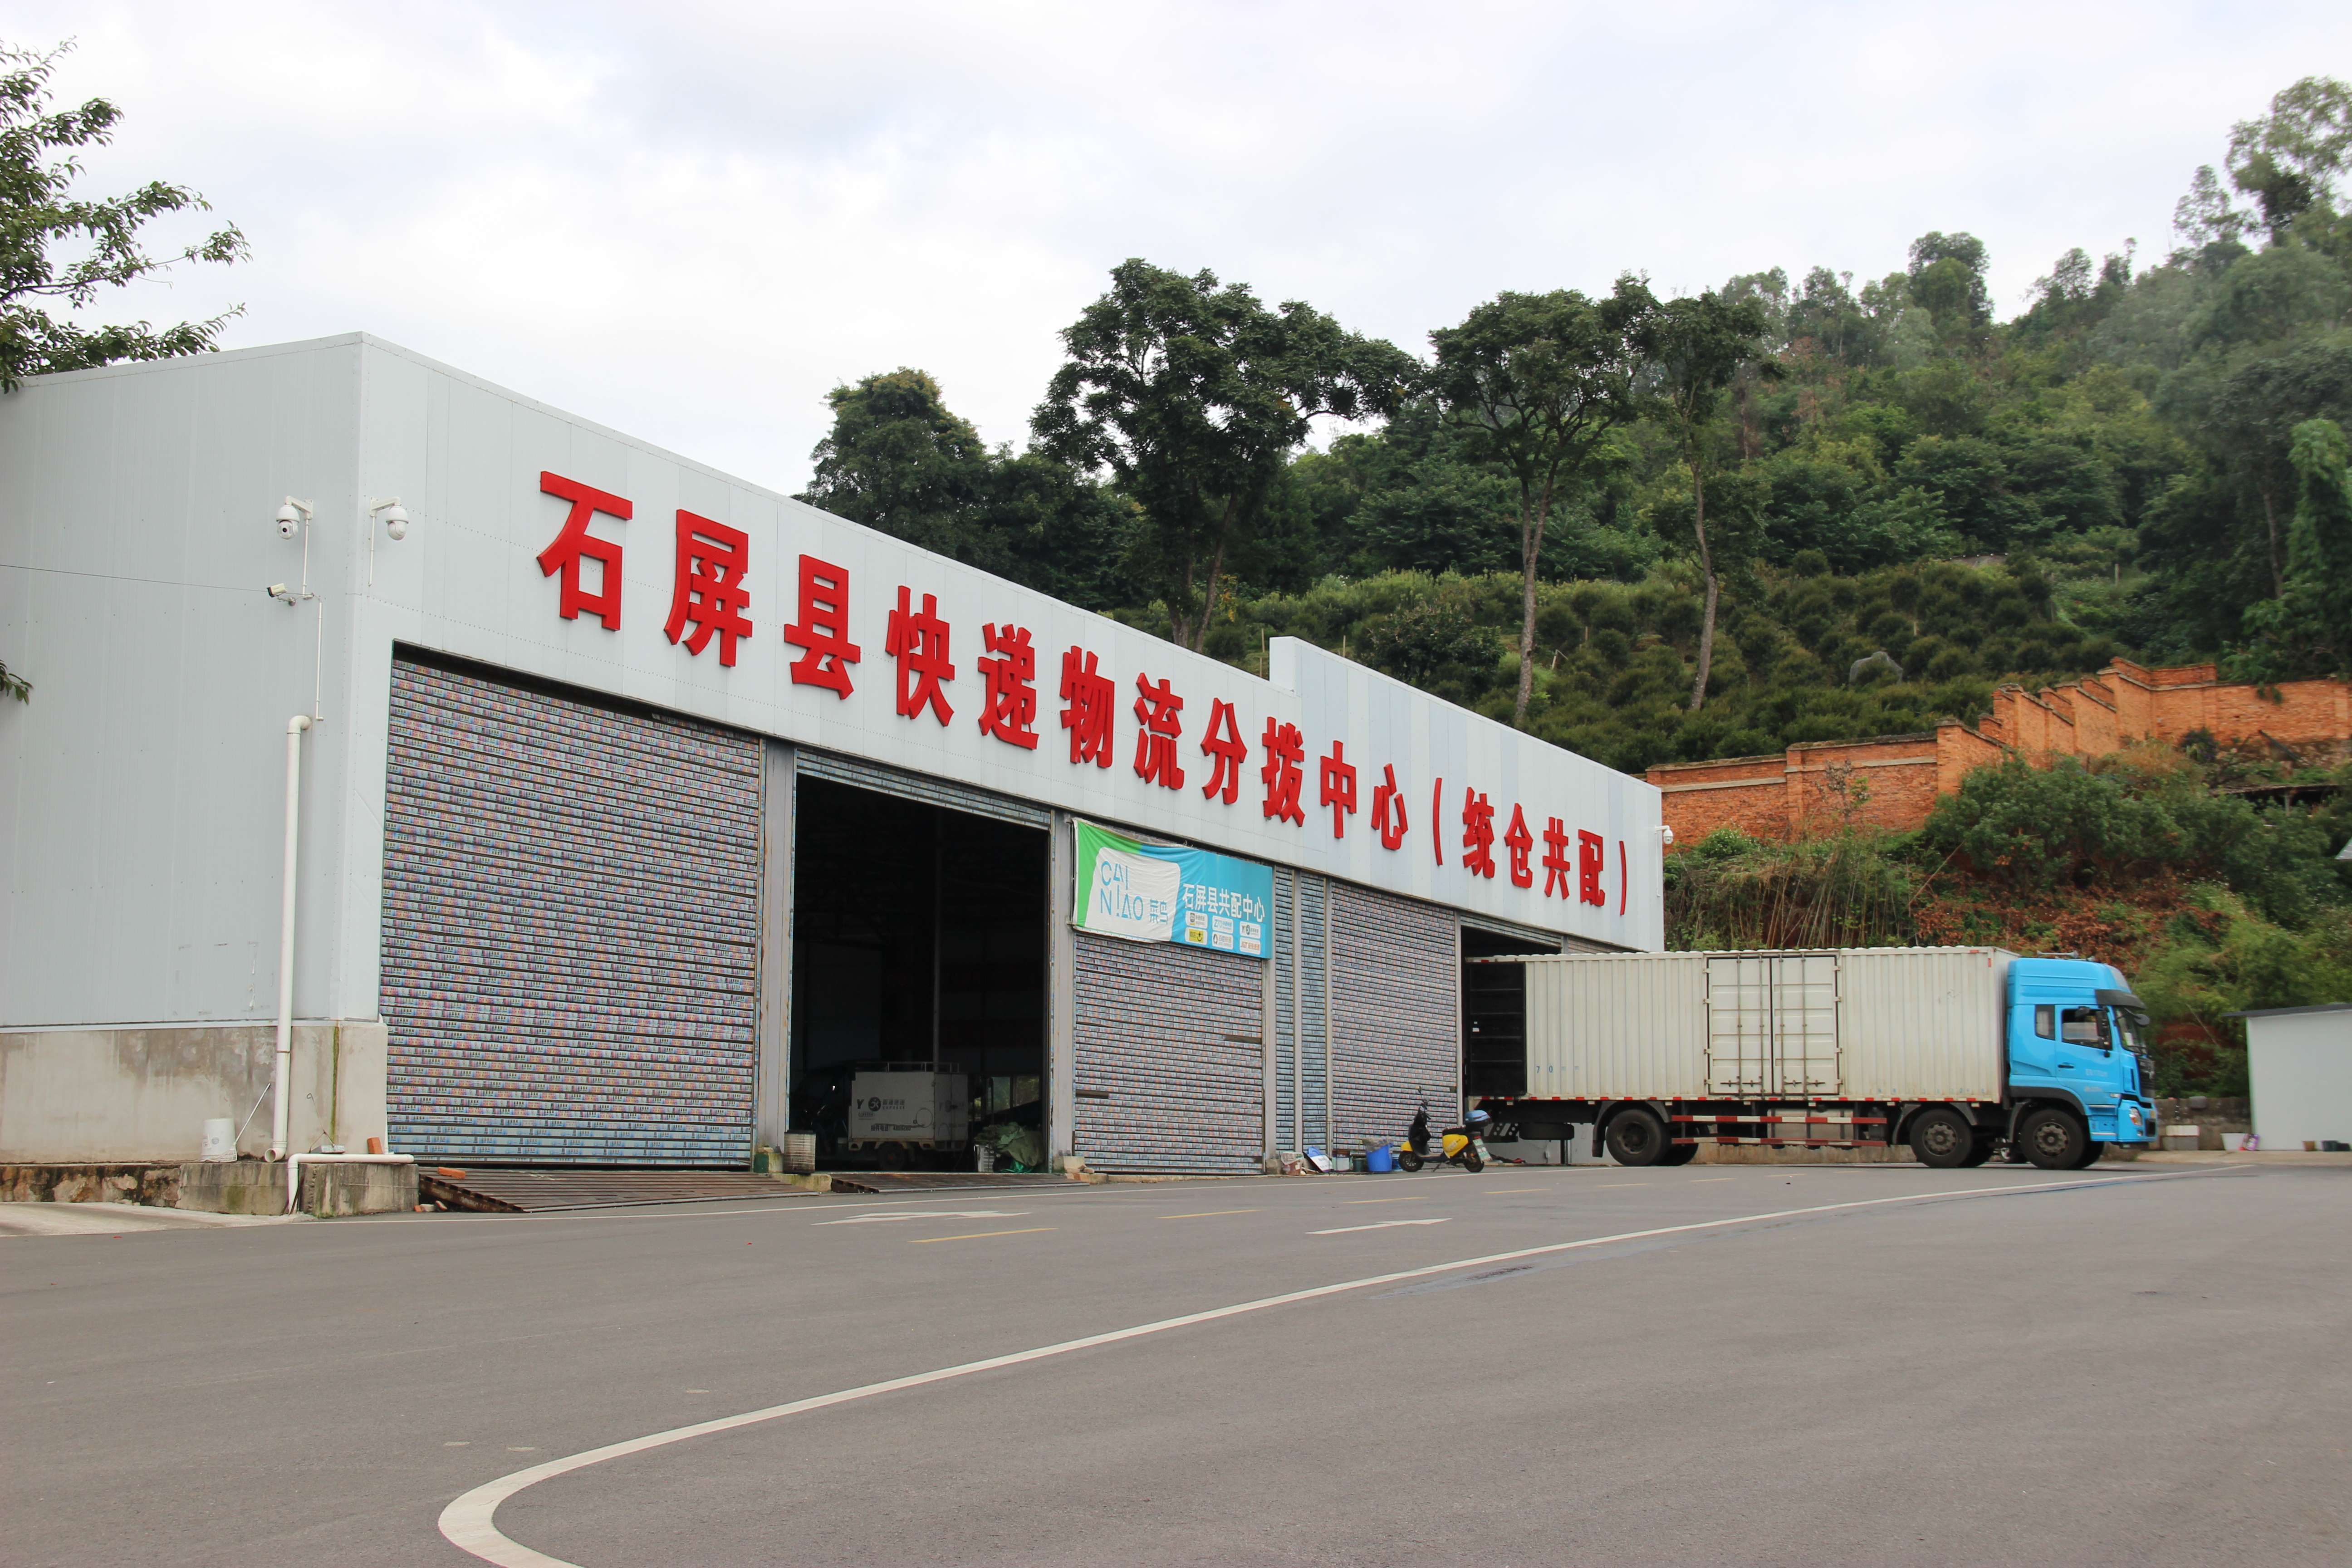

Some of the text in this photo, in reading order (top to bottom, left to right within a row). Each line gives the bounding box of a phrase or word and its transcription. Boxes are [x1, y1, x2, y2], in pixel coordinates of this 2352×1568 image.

[1101, 861, 1128, 890] CAI
[1150, 898, 1168, 925] 菜鸟
[1182, 883, 1265, 922] 石屏县共配中心
